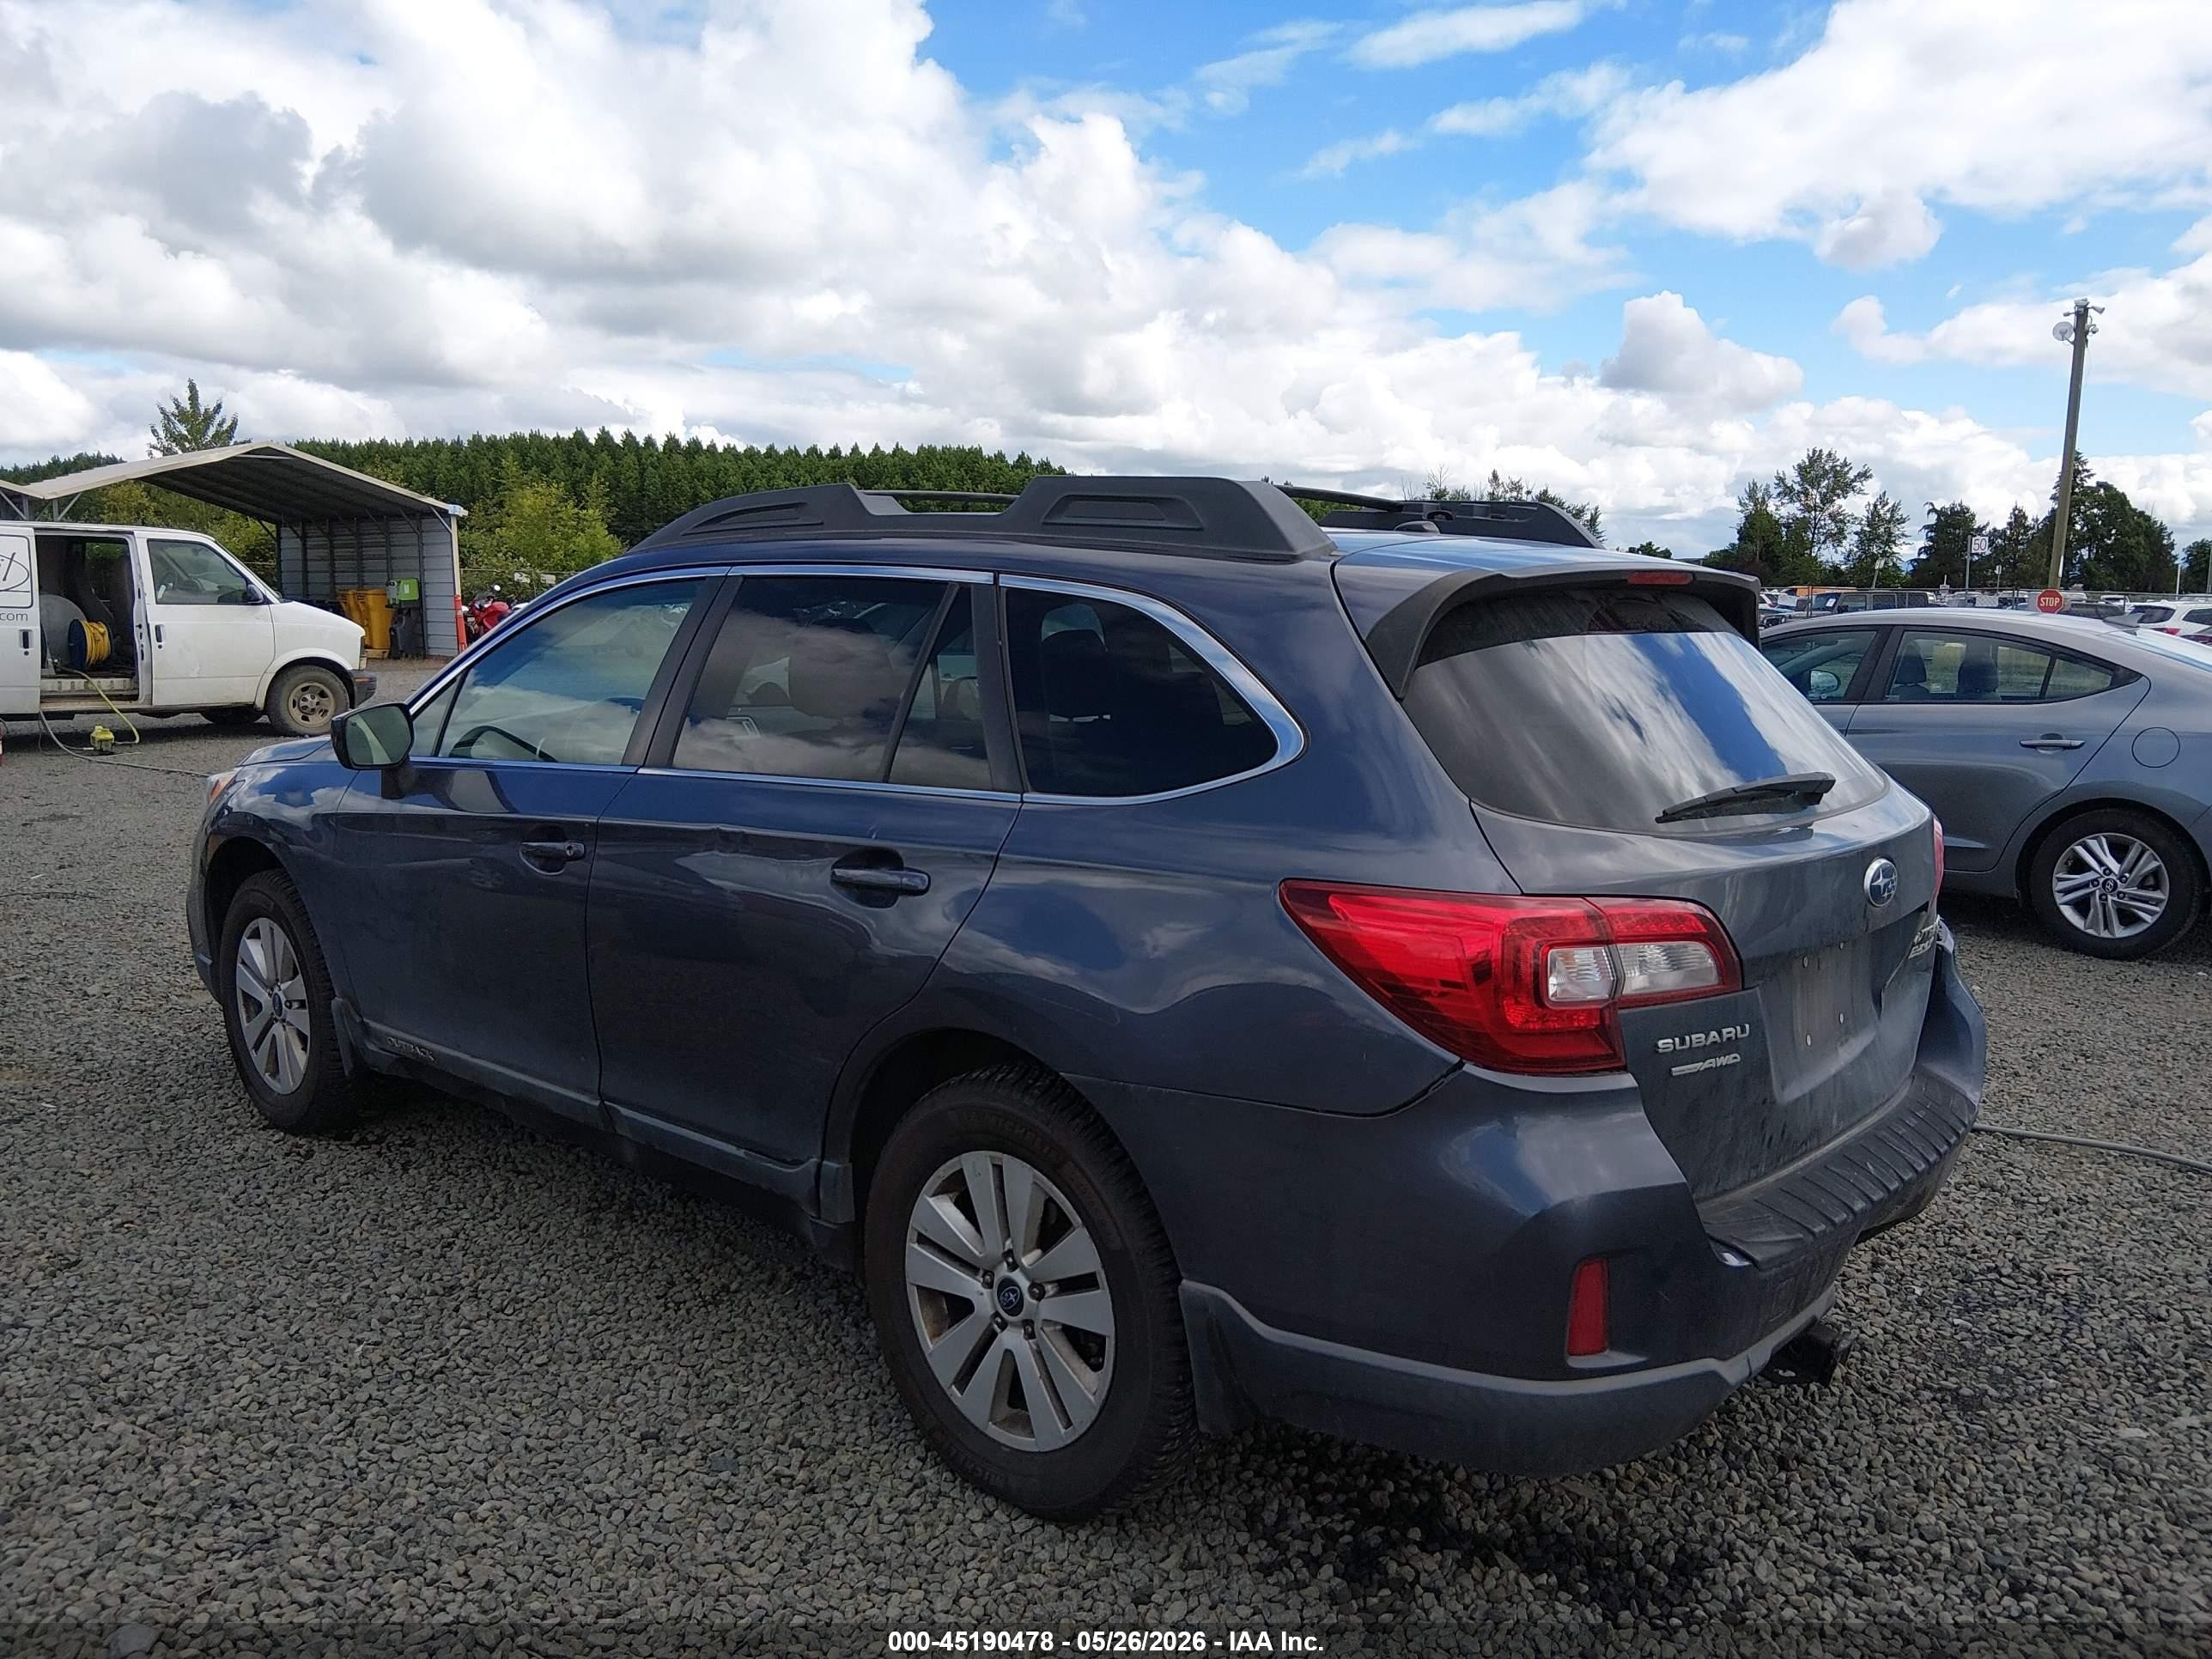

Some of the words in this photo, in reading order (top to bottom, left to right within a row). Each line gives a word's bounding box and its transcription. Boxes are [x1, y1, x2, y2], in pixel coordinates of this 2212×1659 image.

[1973, 538, 1987, 550] 50
[2040, 597, 2059, 606] STOP
[1656, 1024, 1750, 1053] SUBARU
[1699, 1053, 1741, 1072] AWD
